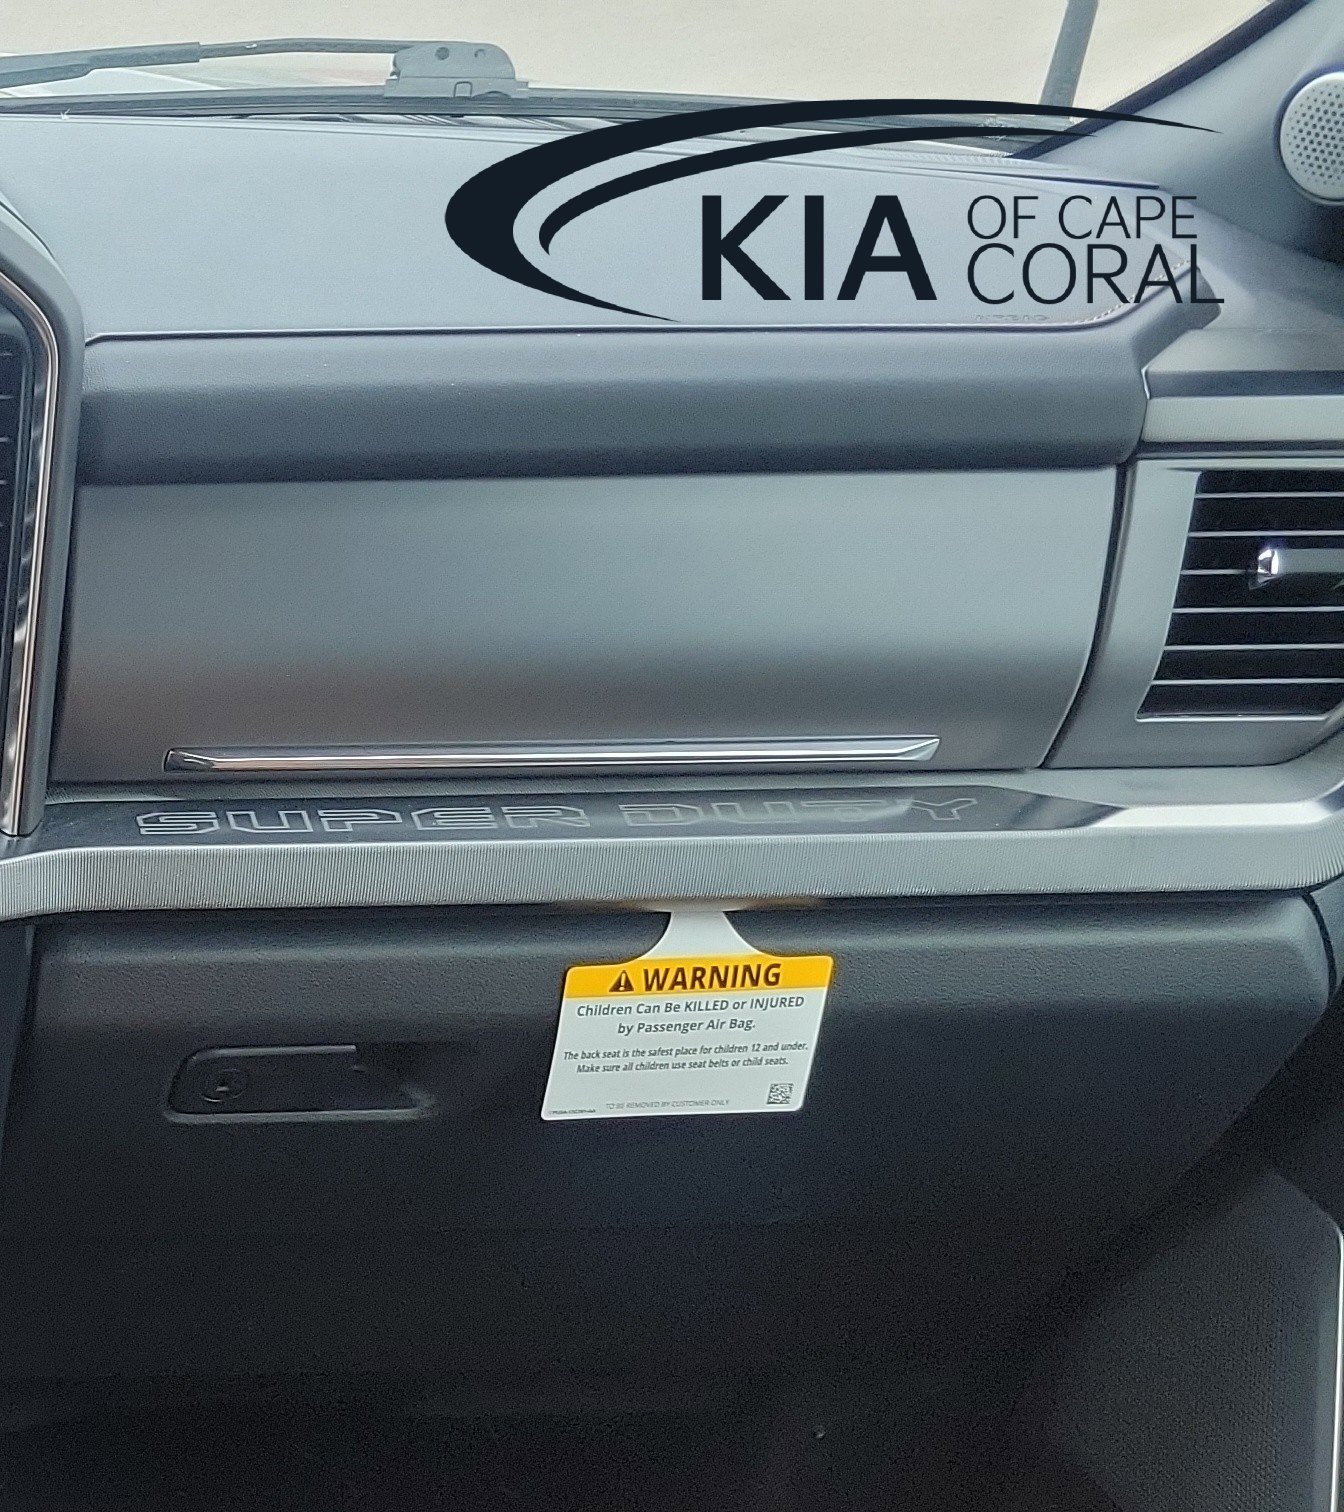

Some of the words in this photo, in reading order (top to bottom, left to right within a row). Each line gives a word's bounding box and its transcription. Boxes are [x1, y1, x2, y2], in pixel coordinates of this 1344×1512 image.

[137, 804, 590, 837] SUPER
[620, 797, 978, 828] DUTY
[643, 963, 782, 992] WARNING
[577, 1003, 633, 1017] Children
[636, 1002, 661, 1014] Can
[664, 1001, 681, 1013] Be
[684, 999, 729, 1013] KILLED
[732, 1000, 747, 1010] or
[750, 996, 805, 1012] INJURED
[617, 1022, 634, 1037] by
[637, 1021, 704, 1035] Passenger
[706, 1018, 726, 1031] Air
[729, 1017, 756, 1031] Bag.
[564, 1050, 579, 1061] The
[580, 1049, 600, 1060] back
[602, 1049, 621, 1059] seat
[631, 1047, 646, 1058] the
[647, 1046, 674, 1057] safest
[674, 1045, 698, 1058] place
[699, 1045, 713, 1055] for
[713, 1043, 749, 1055] children
[751, 1043, 761, 1053] 12
[763, 1042, 780, 1052] and
[781, 1041, 809, 1051] under.
[576, 1064, 600, 1073] Make
[601, 1064, 621, 1072] sure
[622, 1062, 634, 1072] all
[635, 1061, 670, 1071] children
[671, 1061, 687, 1070] use
[687, 1060, 707, 1069] seat
[730, 1059, 741, 1067] or
[742, 1057, 763, 1067] child
[764, 1056, 789, 1067] seats.
